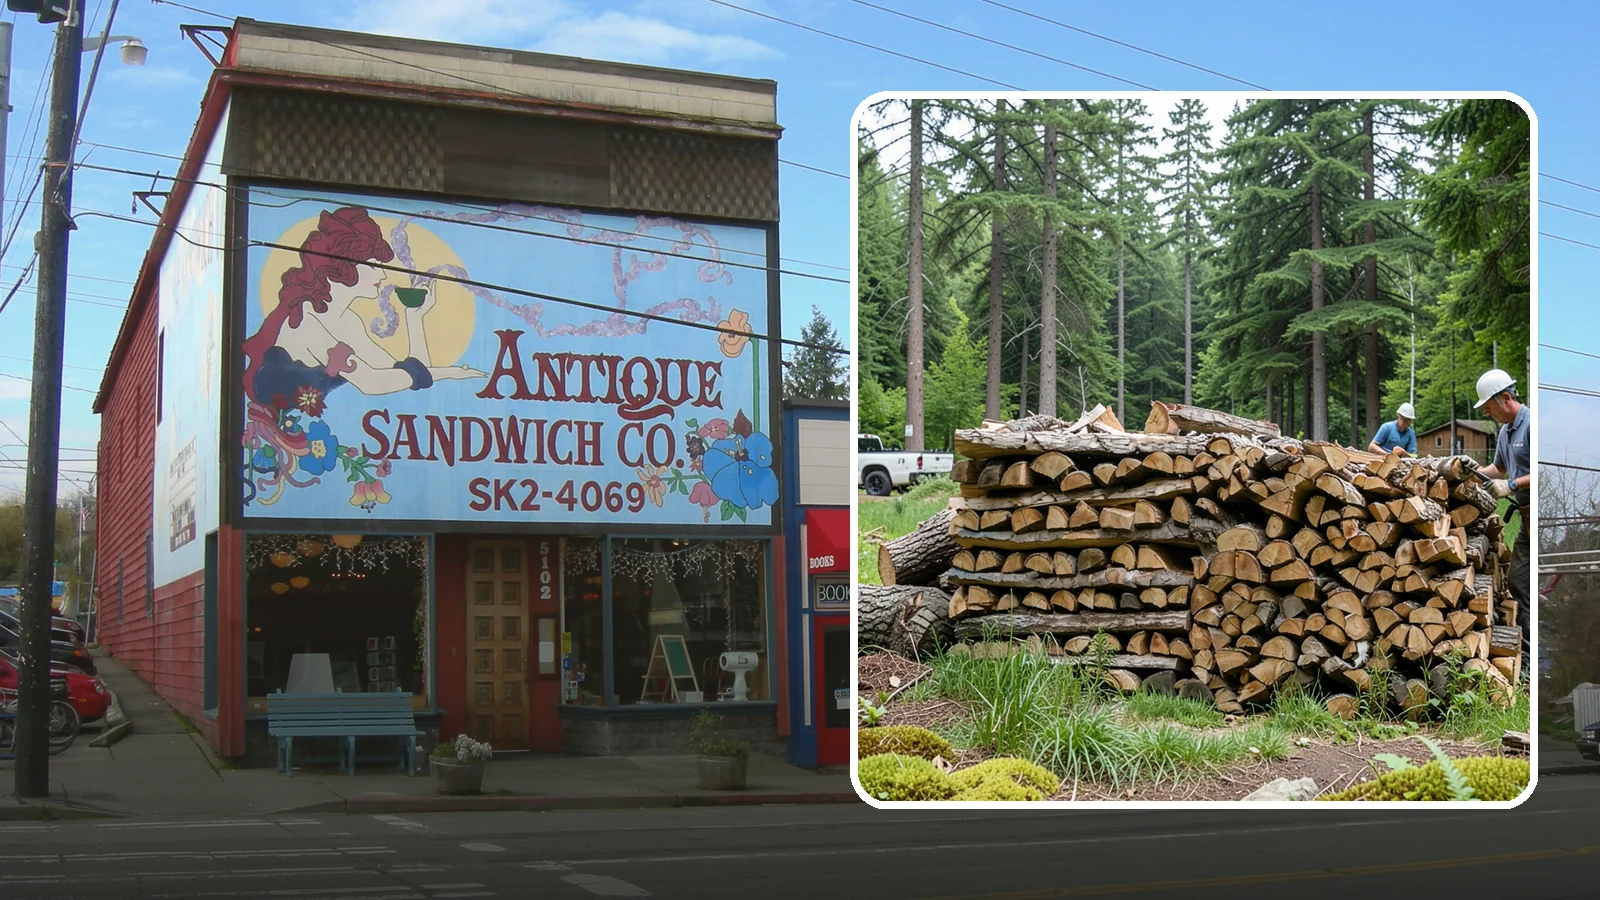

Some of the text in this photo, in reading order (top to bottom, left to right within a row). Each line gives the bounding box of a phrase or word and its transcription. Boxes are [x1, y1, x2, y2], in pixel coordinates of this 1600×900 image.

[476, 329, 723, 420] ANTIQUE
[362, 408, 684, 469] SANDWICH CO.
[469, 478, 645, 512] SK2-4069
[540, 542, 551, 599] 5102
[809, 555, 835, 569] BOOKS
